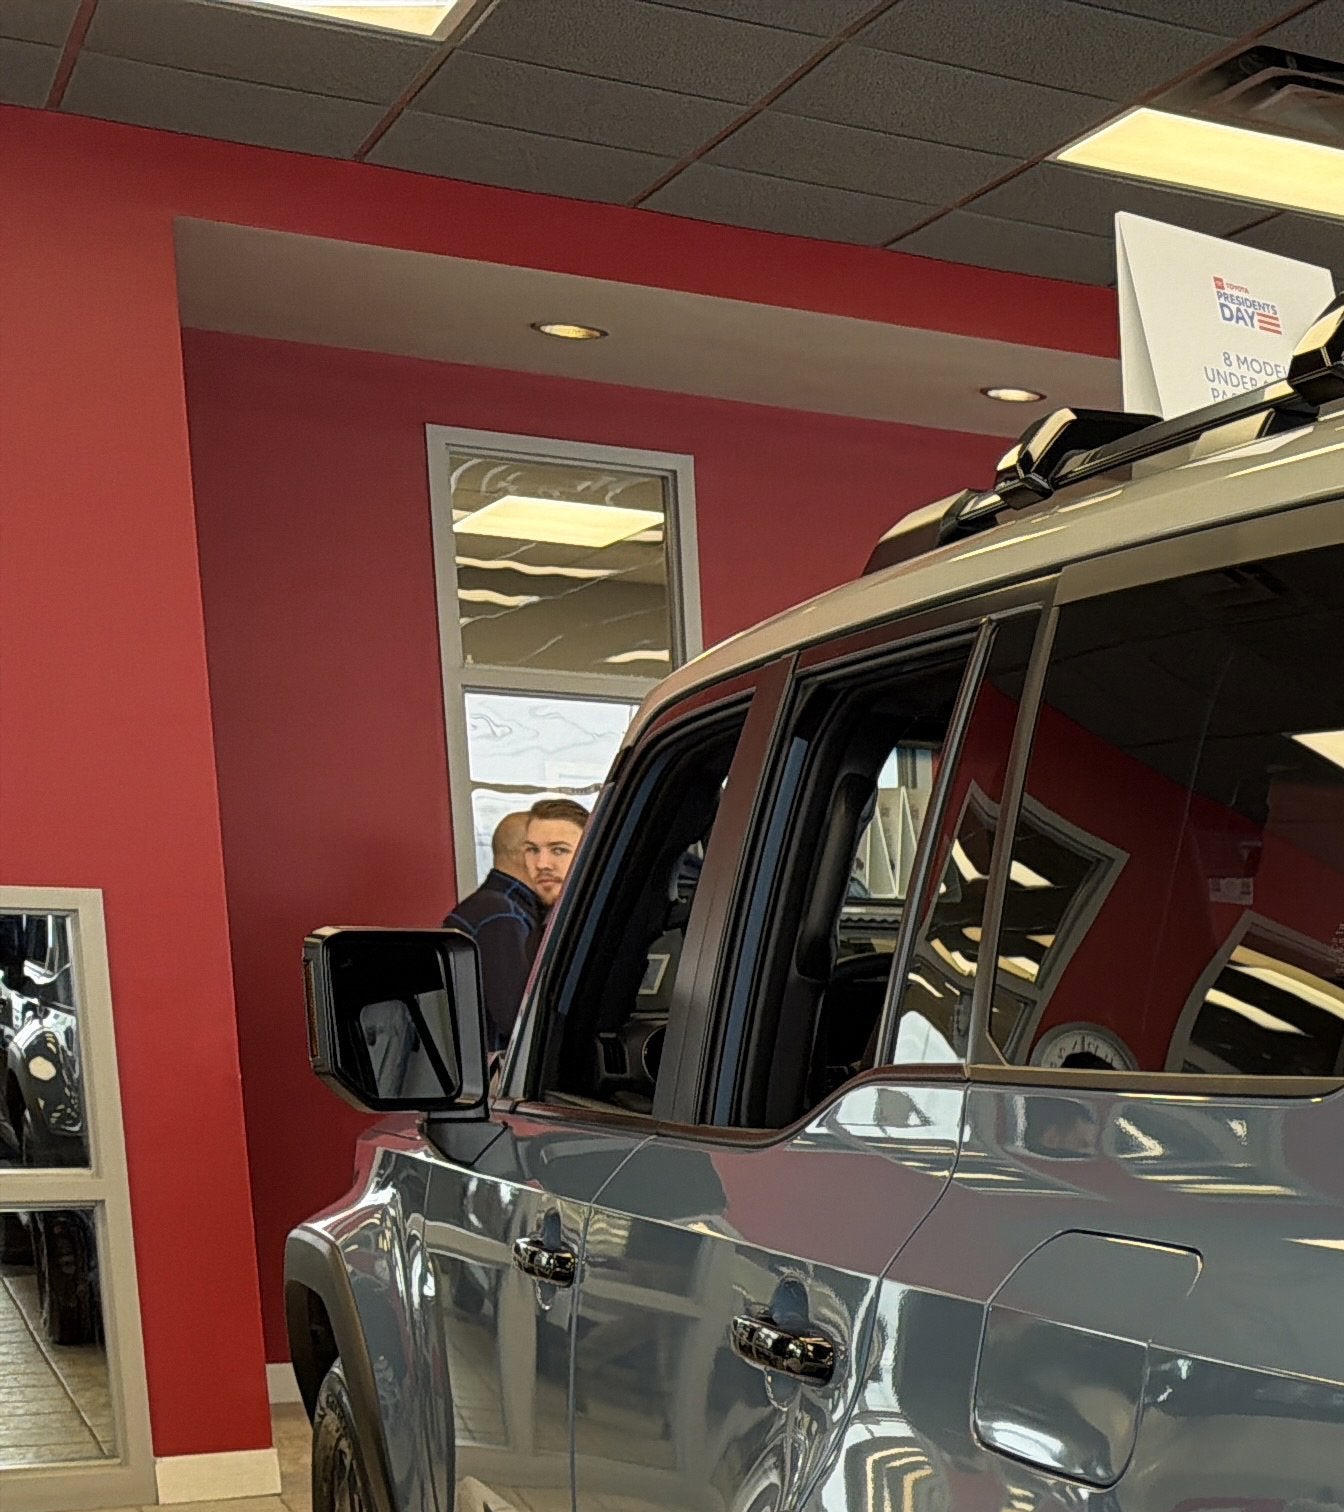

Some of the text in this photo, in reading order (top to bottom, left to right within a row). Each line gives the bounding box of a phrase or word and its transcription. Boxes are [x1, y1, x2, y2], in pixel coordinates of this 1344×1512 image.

[1216, 291, 1277, 315] PRESIDENTS
[1219, 302, 1255, 328] DAY
[1223, 351, 1232, 367] 8
[1203, 366, 1257, 390] UNDER
